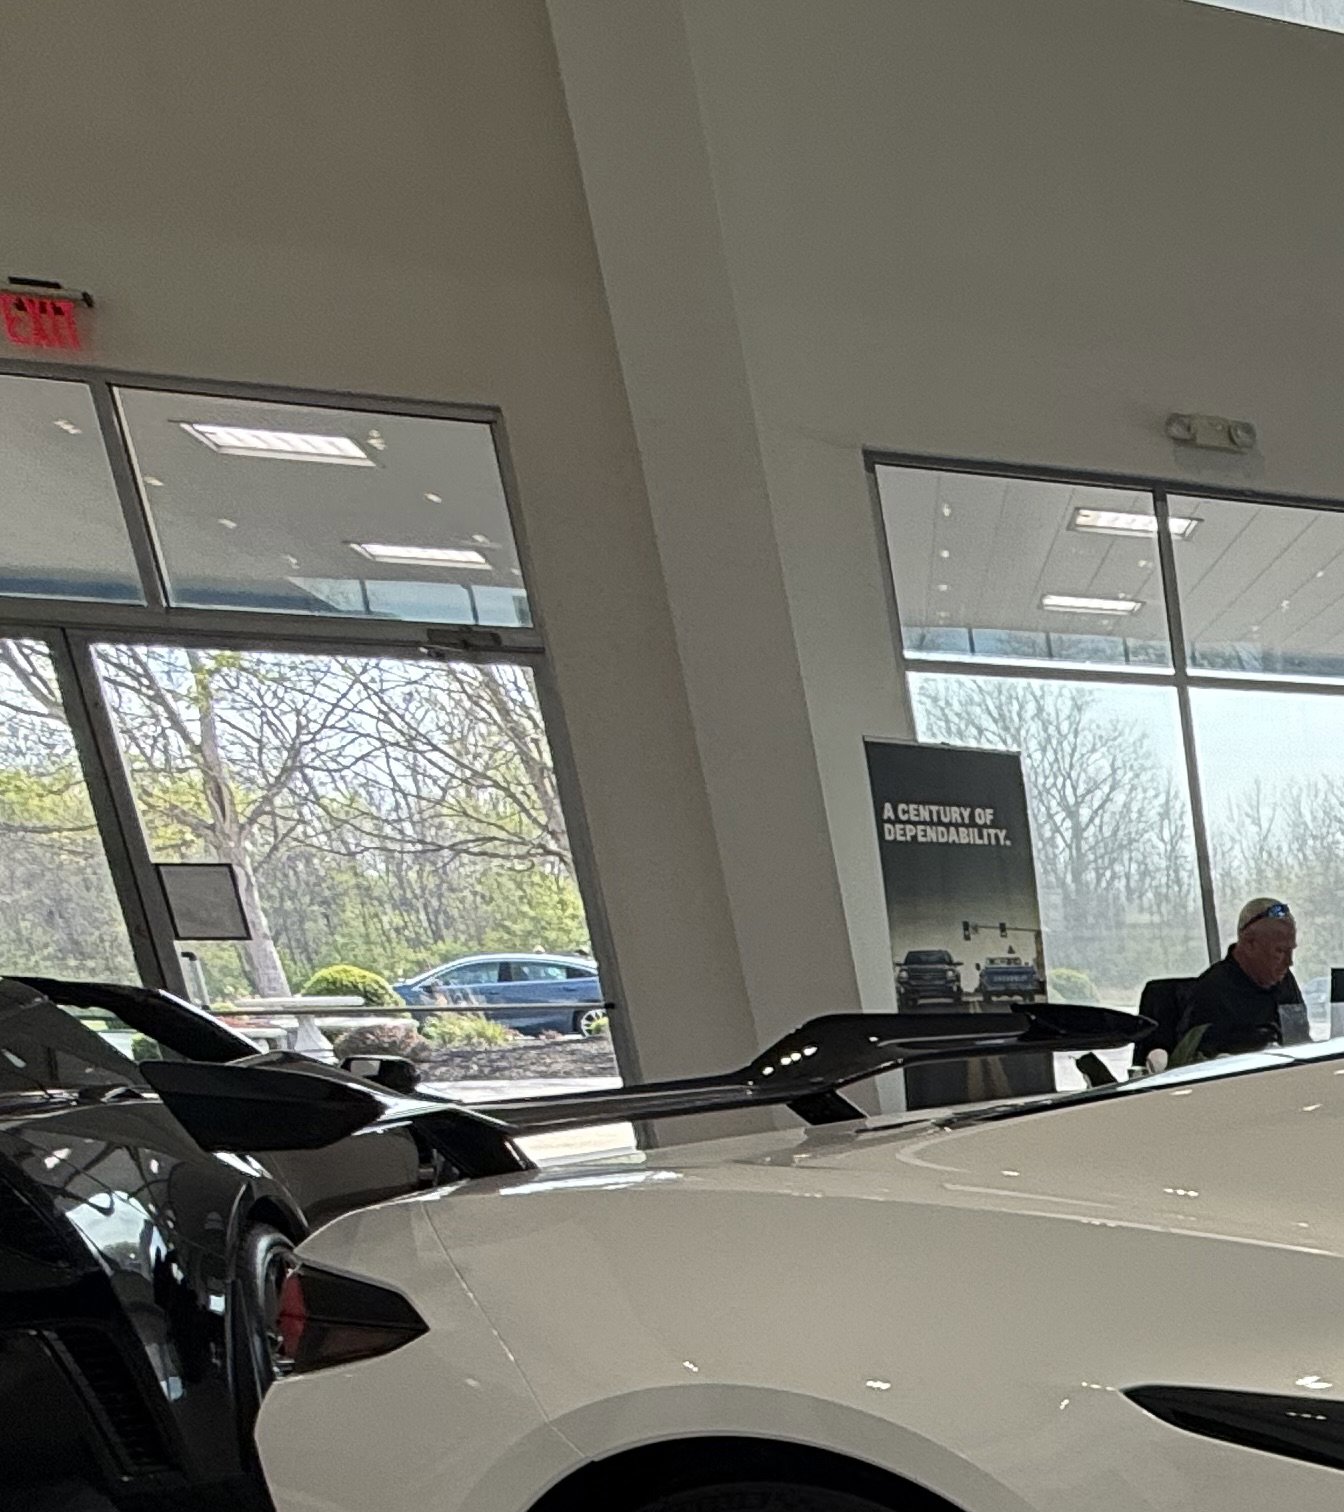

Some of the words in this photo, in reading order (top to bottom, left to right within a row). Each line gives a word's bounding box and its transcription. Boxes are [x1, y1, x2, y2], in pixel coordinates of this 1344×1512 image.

[883, 802, 895, 820] A
[897, 803, 971, 824] CENTURY
[974, 808, 994, 825] OF
[883, 823, 1012, 845] DEPENDABILITY.
